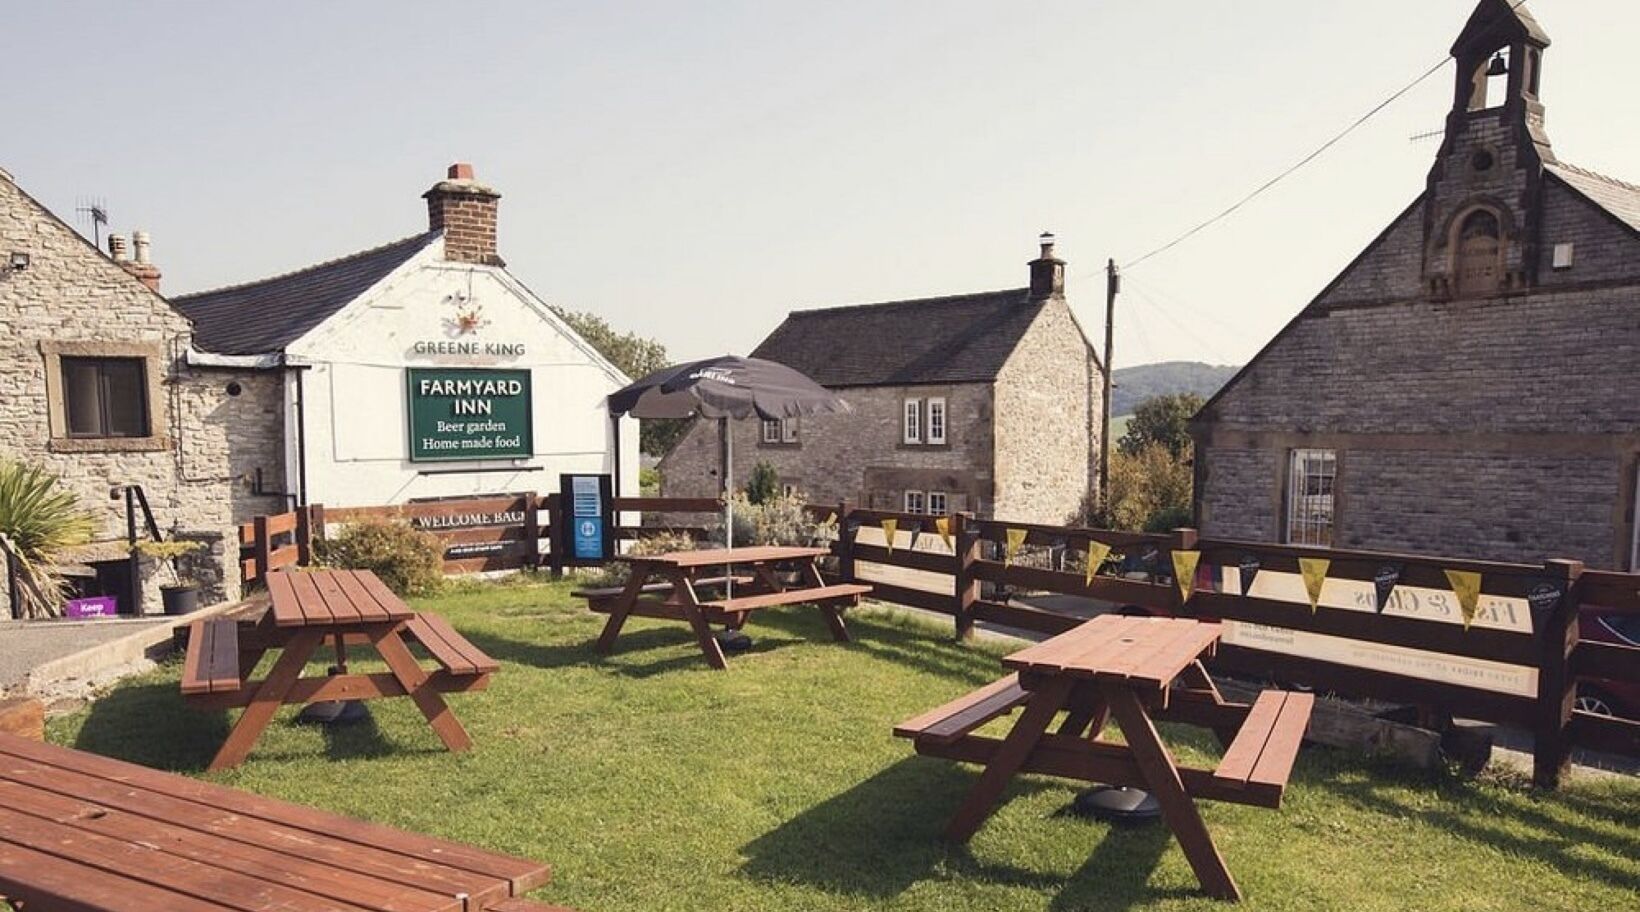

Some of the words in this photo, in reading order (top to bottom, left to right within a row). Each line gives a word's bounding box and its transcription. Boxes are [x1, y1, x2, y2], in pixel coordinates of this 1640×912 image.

[414, 341, 480, 355] GREENE
[485, 343, 526, 356] KING
[420, 379, 522, 396] FARMYARD
[454, 399, 492, 415] INN
[437, 420, 464, 432] Beer
[466, 420, 506, 434] garden
[422, 438, 459, 450] Home
[461, 436, 493, 449] made
[495, 435, 521, 447] food
[419, 511, 491, 528] WELCOME
